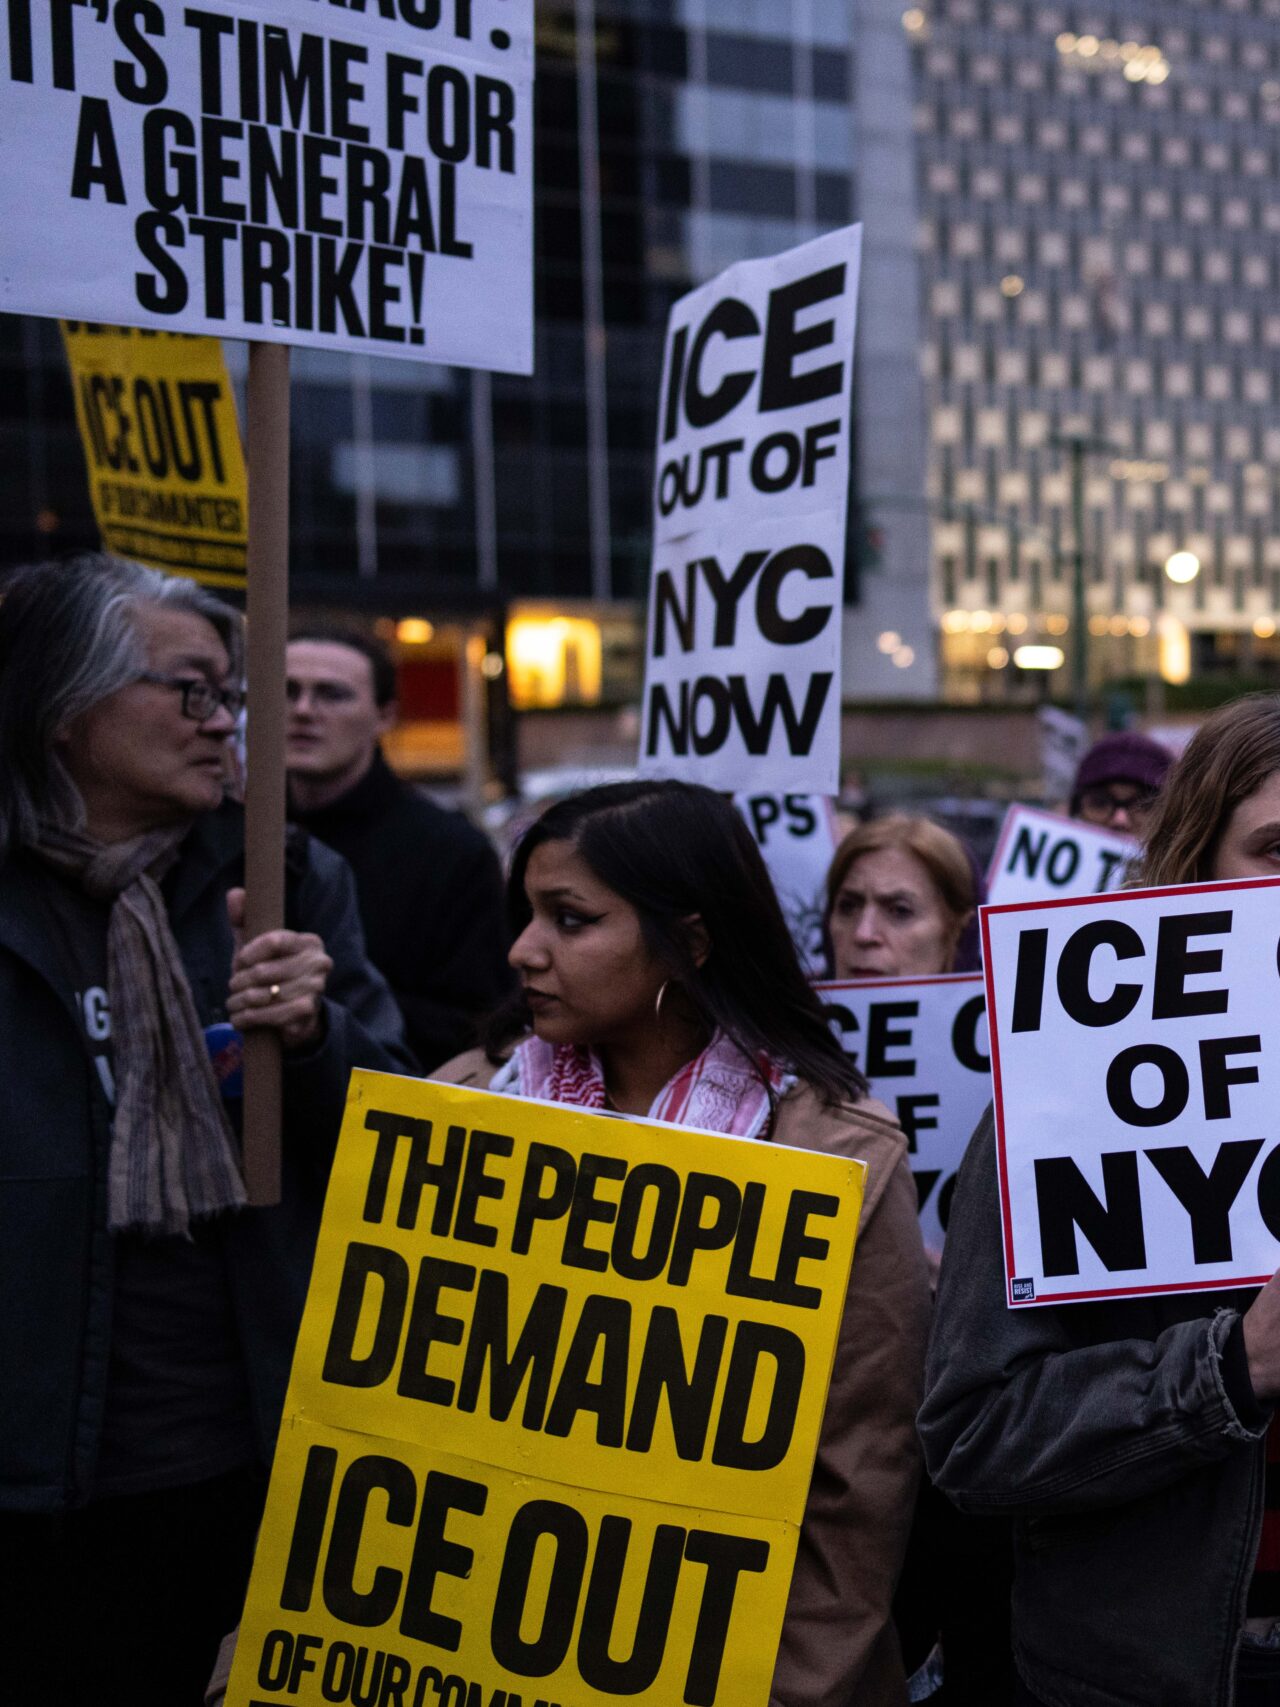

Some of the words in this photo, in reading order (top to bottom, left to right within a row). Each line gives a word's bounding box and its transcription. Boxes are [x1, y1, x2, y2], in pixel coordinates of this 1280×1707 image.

[8, 0, 168, 105] IT'S
[184, 7, 370, 143] TIME
[386, 51, 516, 174] FOR
[70, 95, 127, 205] A
[143, 107, 474, 259] GENERAL
[134, 210, 426, 345] STRIKE!
[663, 262, 847, 443] ICE
[133, 378, 224, 484] OUT
[659, 439, 744, 516] OUT
[750, 420, 841, 495] OF
[654, 544, 835, 658] NYC
[646, 672, 834, 757] NOW
[1006, 826, 1081, 886] NO
[1011, 909, 1233, 1033] ICE
[1106, 1035, 1262, 1127] OF
[362, 1109, 514, 1247] THE
[511, 1141, 839, 1309] PEOPLE
[321, 1241, 805, 1471] DEMAND
[279, 1444, 488, 1651] ICE
[490, 1499, 769, 1707] OUT
[257, 1629, 323, 1694] OF
[321, 1641, 411, 1707] OUR
